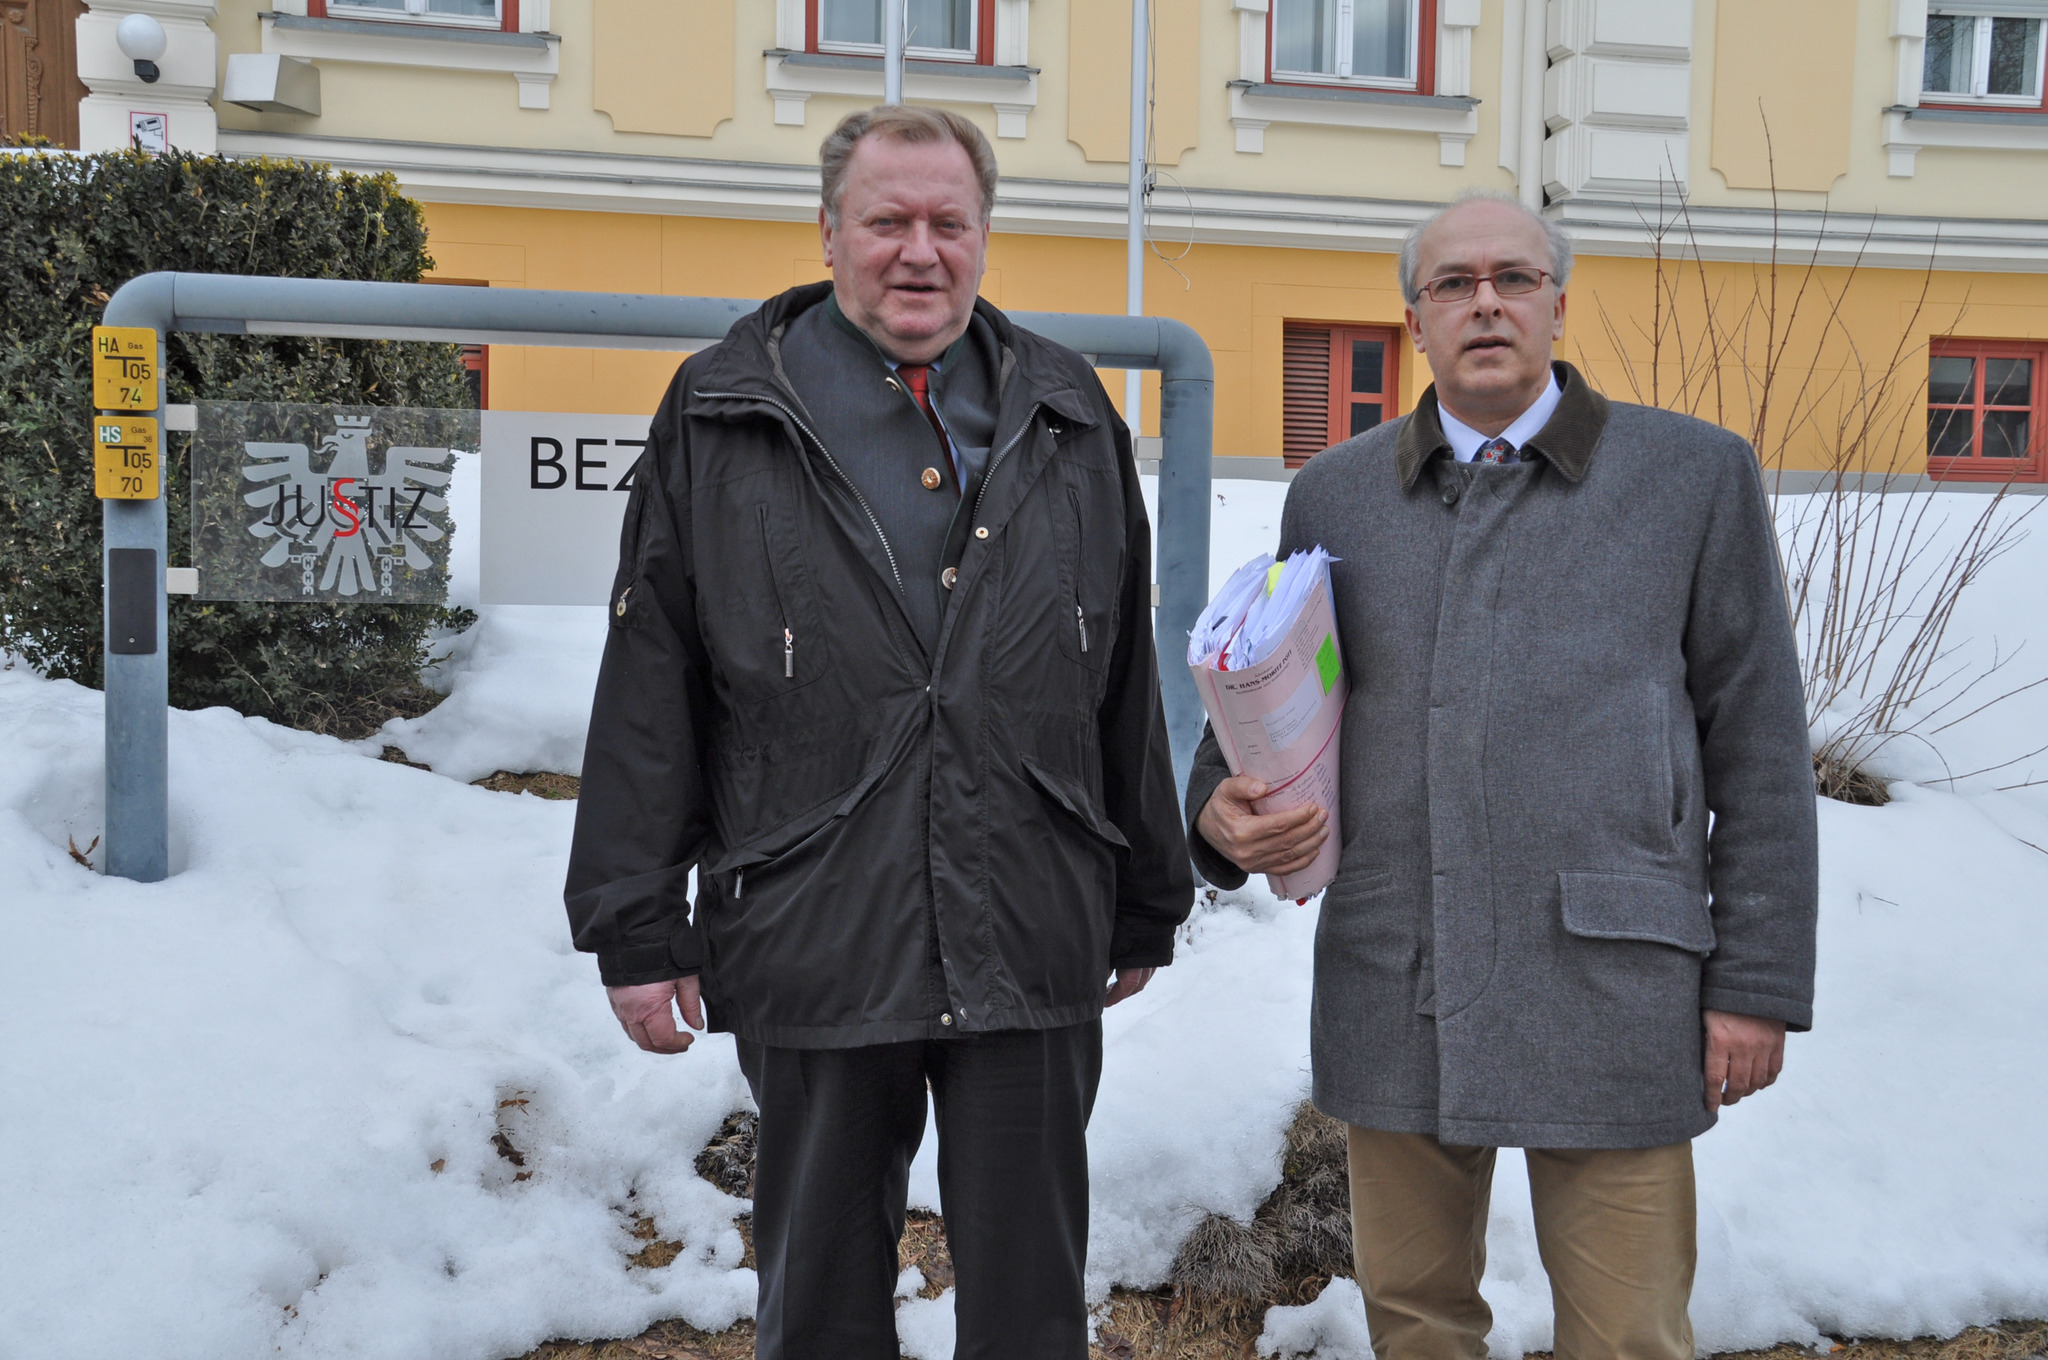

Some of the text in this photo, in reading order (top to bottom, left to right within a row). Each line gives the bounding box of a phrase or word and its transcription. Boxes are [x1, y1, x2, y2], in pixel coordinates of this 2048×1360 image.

[98, 337, 144, 353] HA Gas
[99, 426, 121, 443] HS
